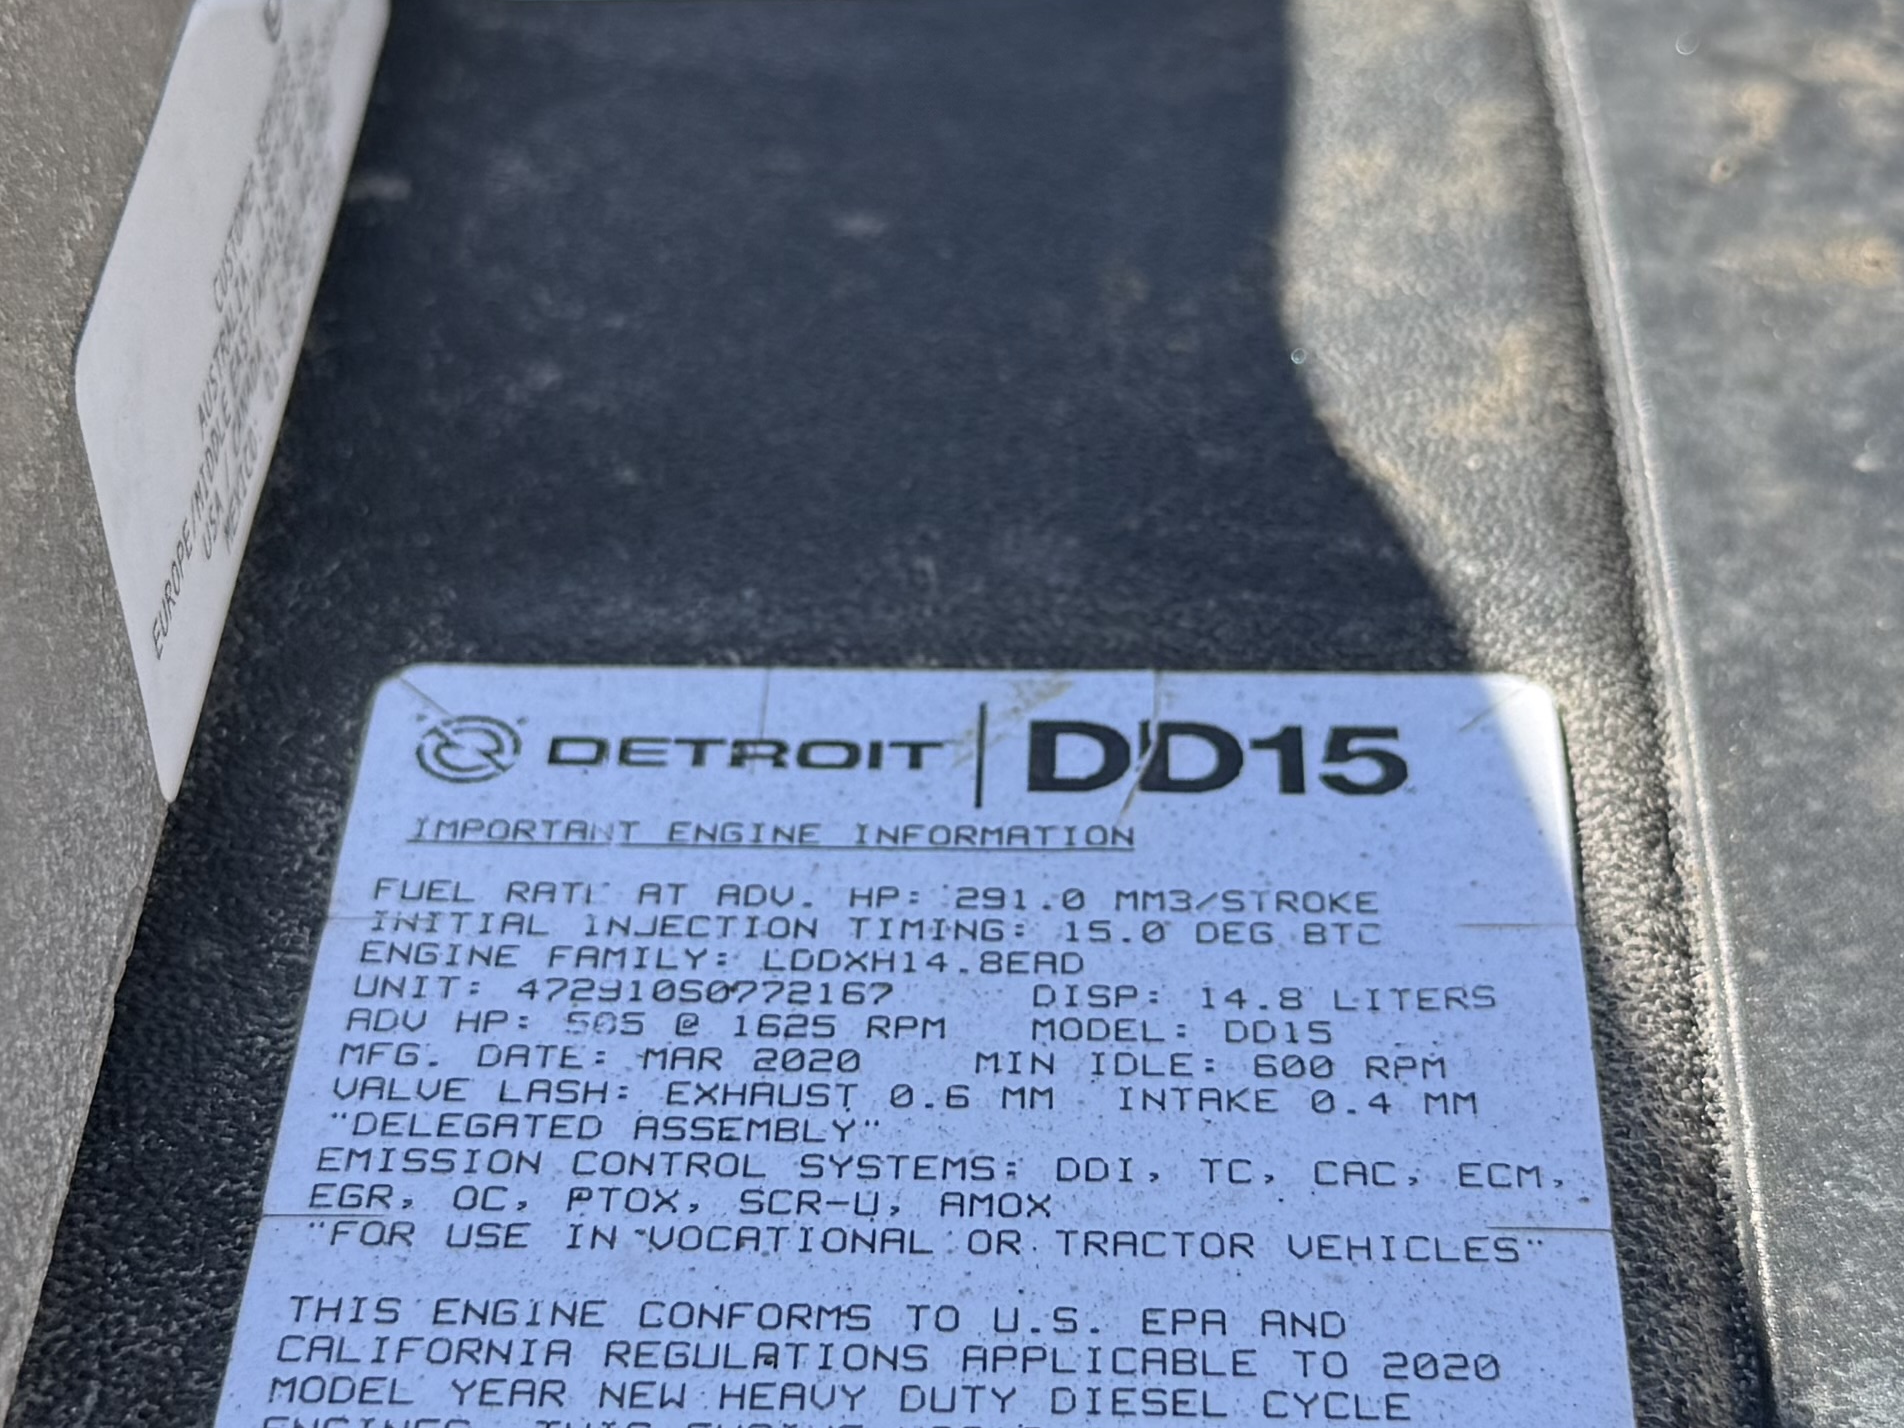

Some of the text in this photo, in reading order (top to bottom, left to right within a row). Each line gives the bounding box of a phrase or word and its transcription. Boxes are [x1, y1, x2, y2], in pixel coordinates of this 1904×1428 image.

[151, 379, 231, 662] EUROPE/MIDDLE
[548, 718, 1410, 798] DETROIT DD15
[414, 814, 1135, 849] IMPORTANT ENGINE INFORMATION
[371, 876, 475, 903] FUEL
[636, 881, 688, 906] AT
[715, 882, 813, 909] ADV.
[848, 884, 919, 908] HP:
[954, 885, 1085, 912] 291.0
[1113, 888, 1379, 915] MM3/STROKE
[367, 909, 1381, 947] INITIAL INJECTION TIMING: 15.0 DEG BTC
[357, 938, 521, 969] ENGINE
[546, 944, 727, 971] FAMILY:
[352, 973, 480, 1000] UNIT:
[1031, 982, 1158, 1009] DISP:
[1201, 986, 1304, 1011] 14.8
[1332, 983, 1497, 1013] LITERS
[343, 1007, 1332, 1046] ADV HP: 505 @ 1625 RPM MODEL: DD15
[337, 1041, 1447, 1082] MFG. DATE: MAR 2020 MIN IDLE: 600 RPM
[331, 1074, 1478, 1119] VALVE LASH: EXHAUST 0.6 MM INTAKE 0.4 MM
[314, 1145, 1564, 1189] EMISSION CONTROL SYSTEMS: DDI, TC, CAC, ECM,
[307, 1182, 1052, 1220] EGR, OC, PTOX, SCR-U, AMOX
[444, 1221, 532, 1252] USE
[564, 1222, 617, 1251] IN
[647, 1223, 934, 1255] VOCATIONAL
[966, 1228, 1022, 1256] OR
[1054, 1228, 1255, 1260] TRACTOR
[288, 1294, 1347, 1340] THIS ENGINE CONFORMS TO U.S. EPA AND
[275, 1333, 1501, 1383] CALIFORNIA REGULATIONS APPLICABLE TO 2020
[266, 1374, 1412, 1423] MODEL YEAR NEW HEAVY DUTY DIESEL CYCLE
